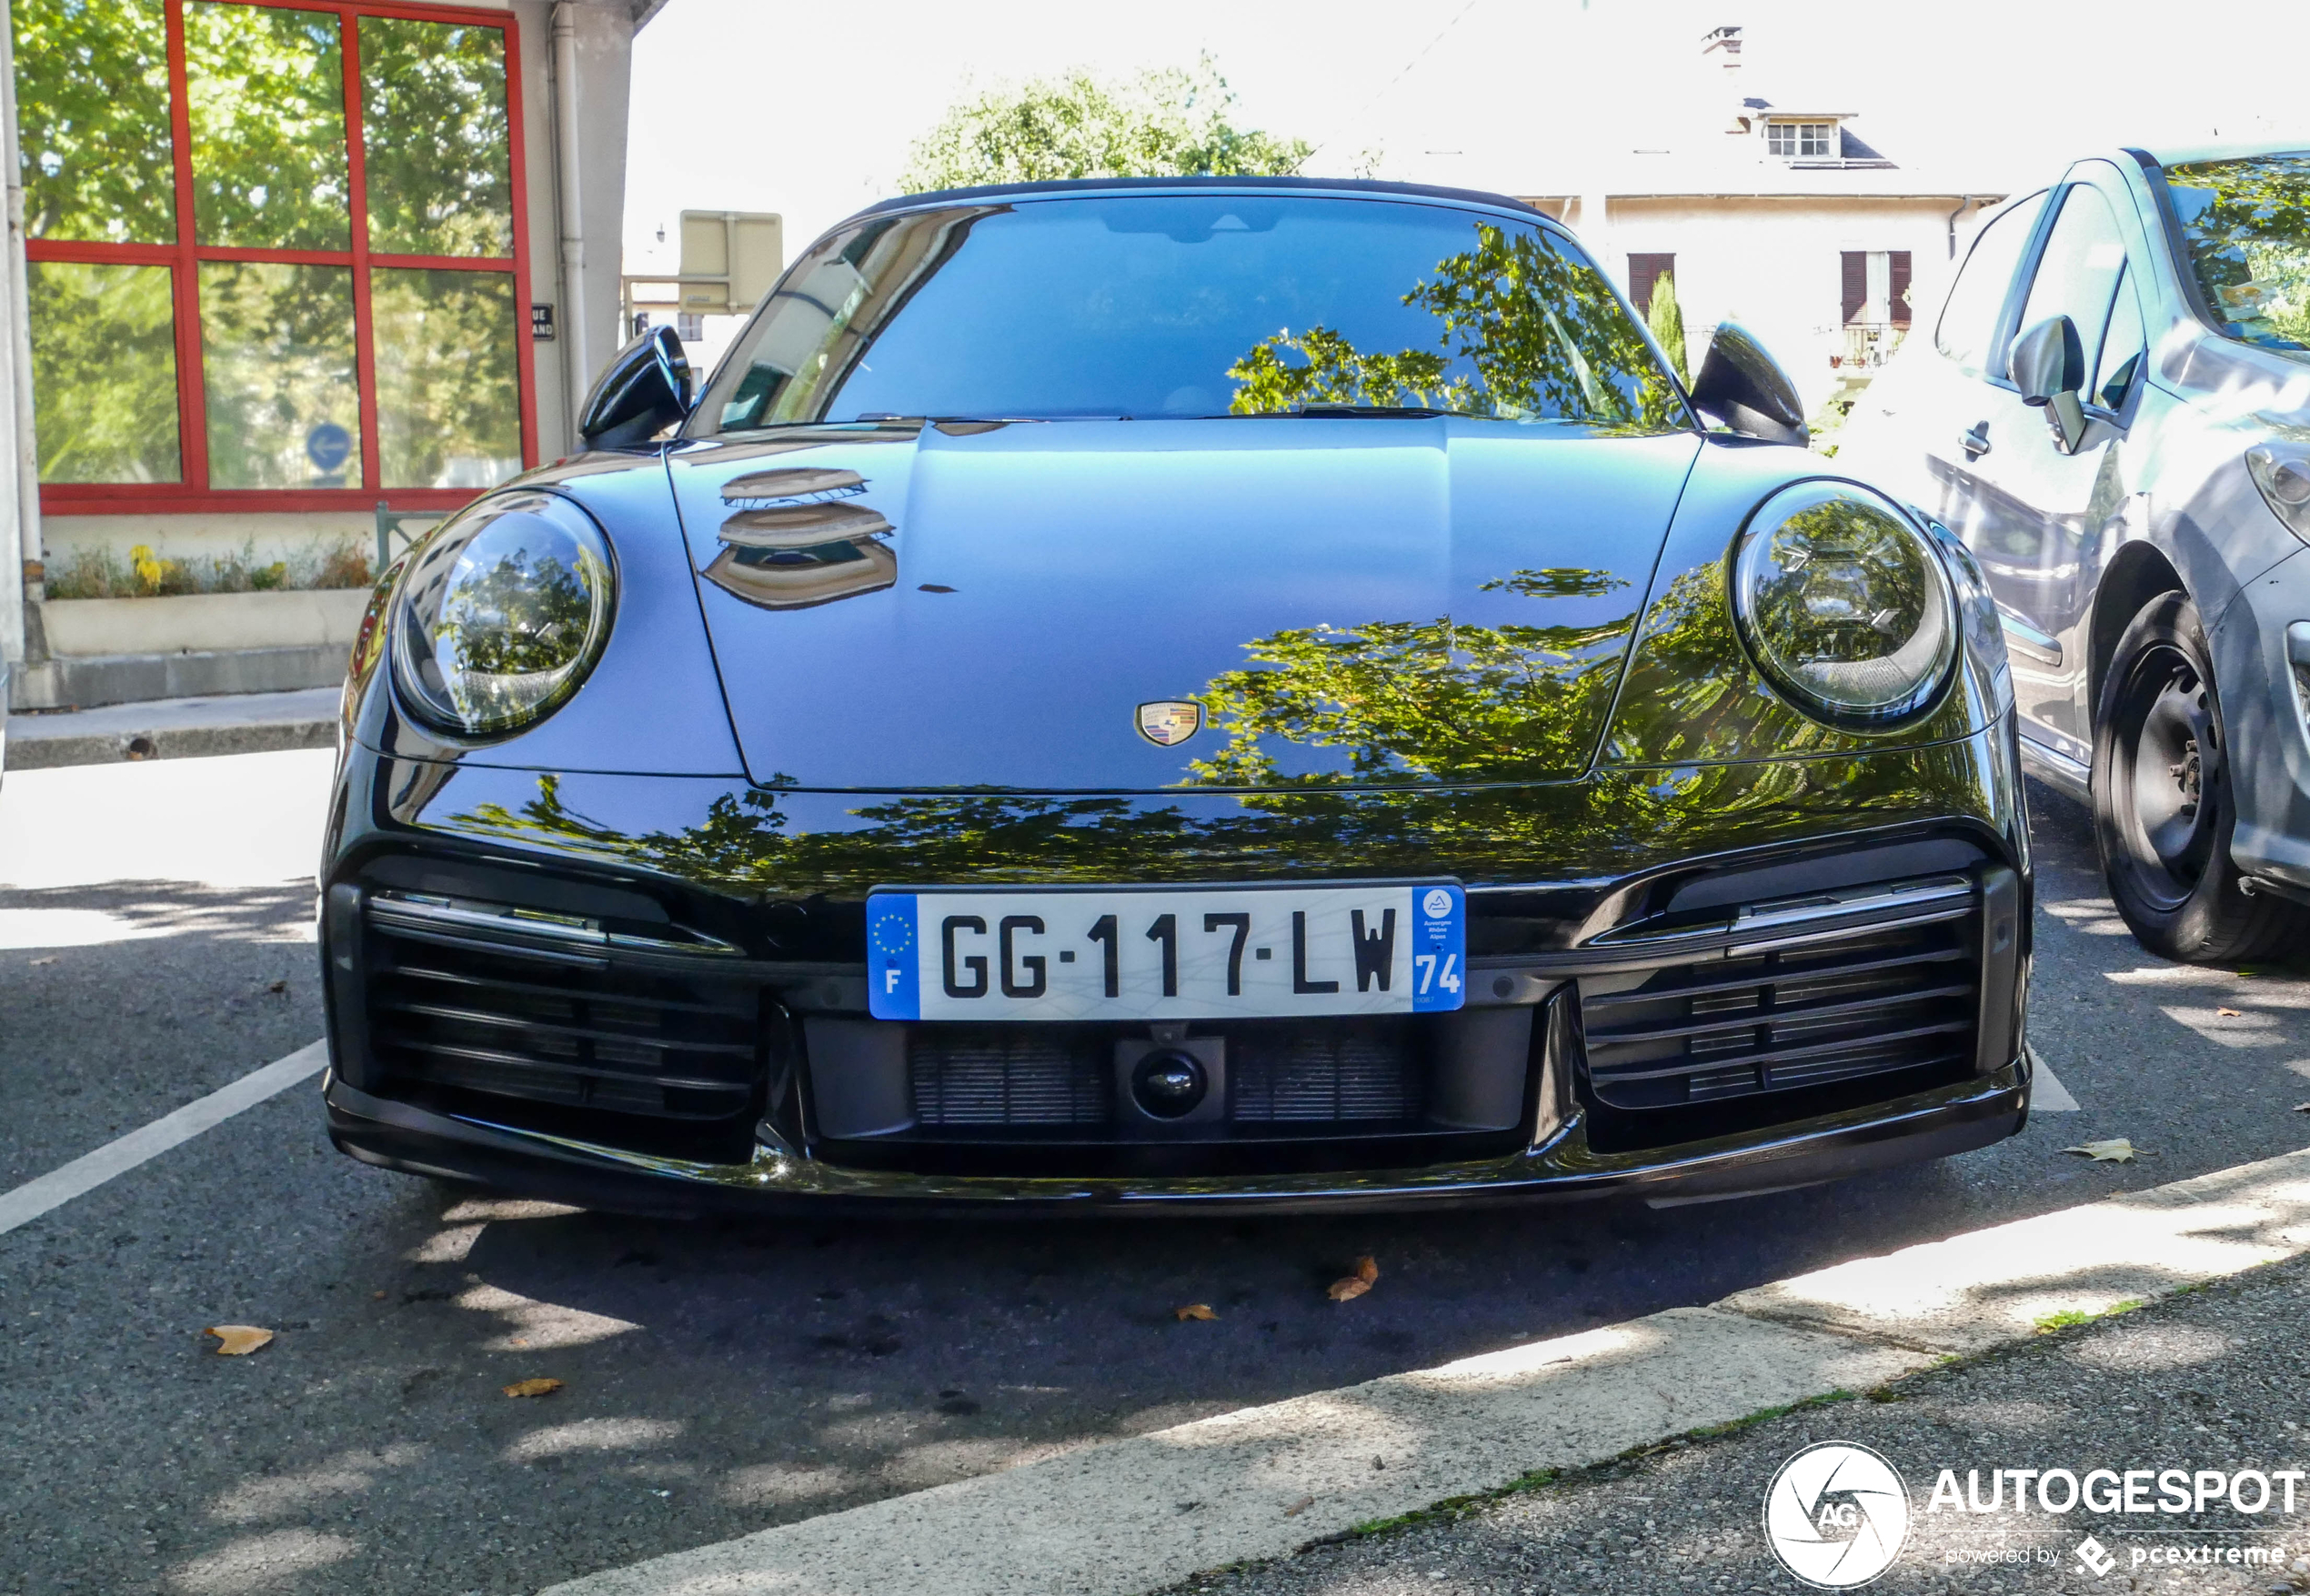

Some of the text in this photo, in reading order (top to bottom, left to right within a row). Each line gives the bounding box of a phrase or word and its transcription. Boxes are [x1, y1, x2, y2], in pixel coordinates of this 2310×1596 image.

[532, 309, 546, 321] UE
[532, 324, 553, 336] AND
[940, 908, 1396, 999] GG-117-LW
[885, 969, 900, 994] F
[1415, 953, 1461, 995] 74
